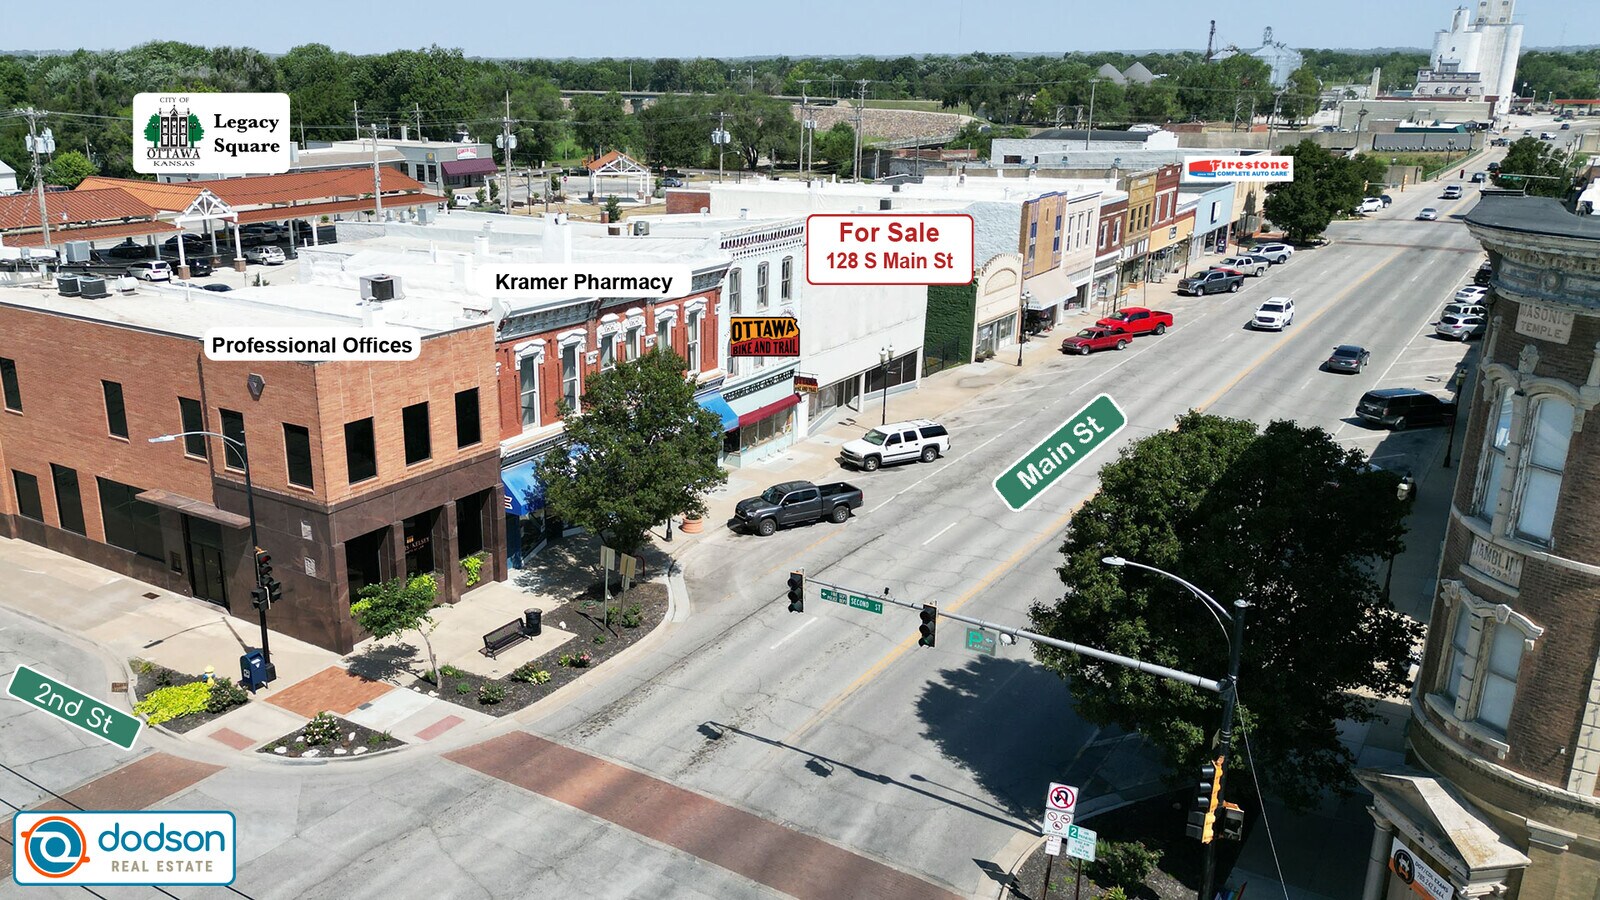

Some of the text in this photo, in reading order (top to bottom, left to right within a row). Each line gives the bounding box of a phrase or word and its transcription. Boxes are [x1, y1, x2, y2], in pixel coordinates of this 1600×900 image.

[1519, 303, 1570, 326] MASONIC
[850, 597, 881, 612] SECOND ST
[1070, 828, 1077, 837] 2
[1434, 878, 1449, 893] EXAMS
